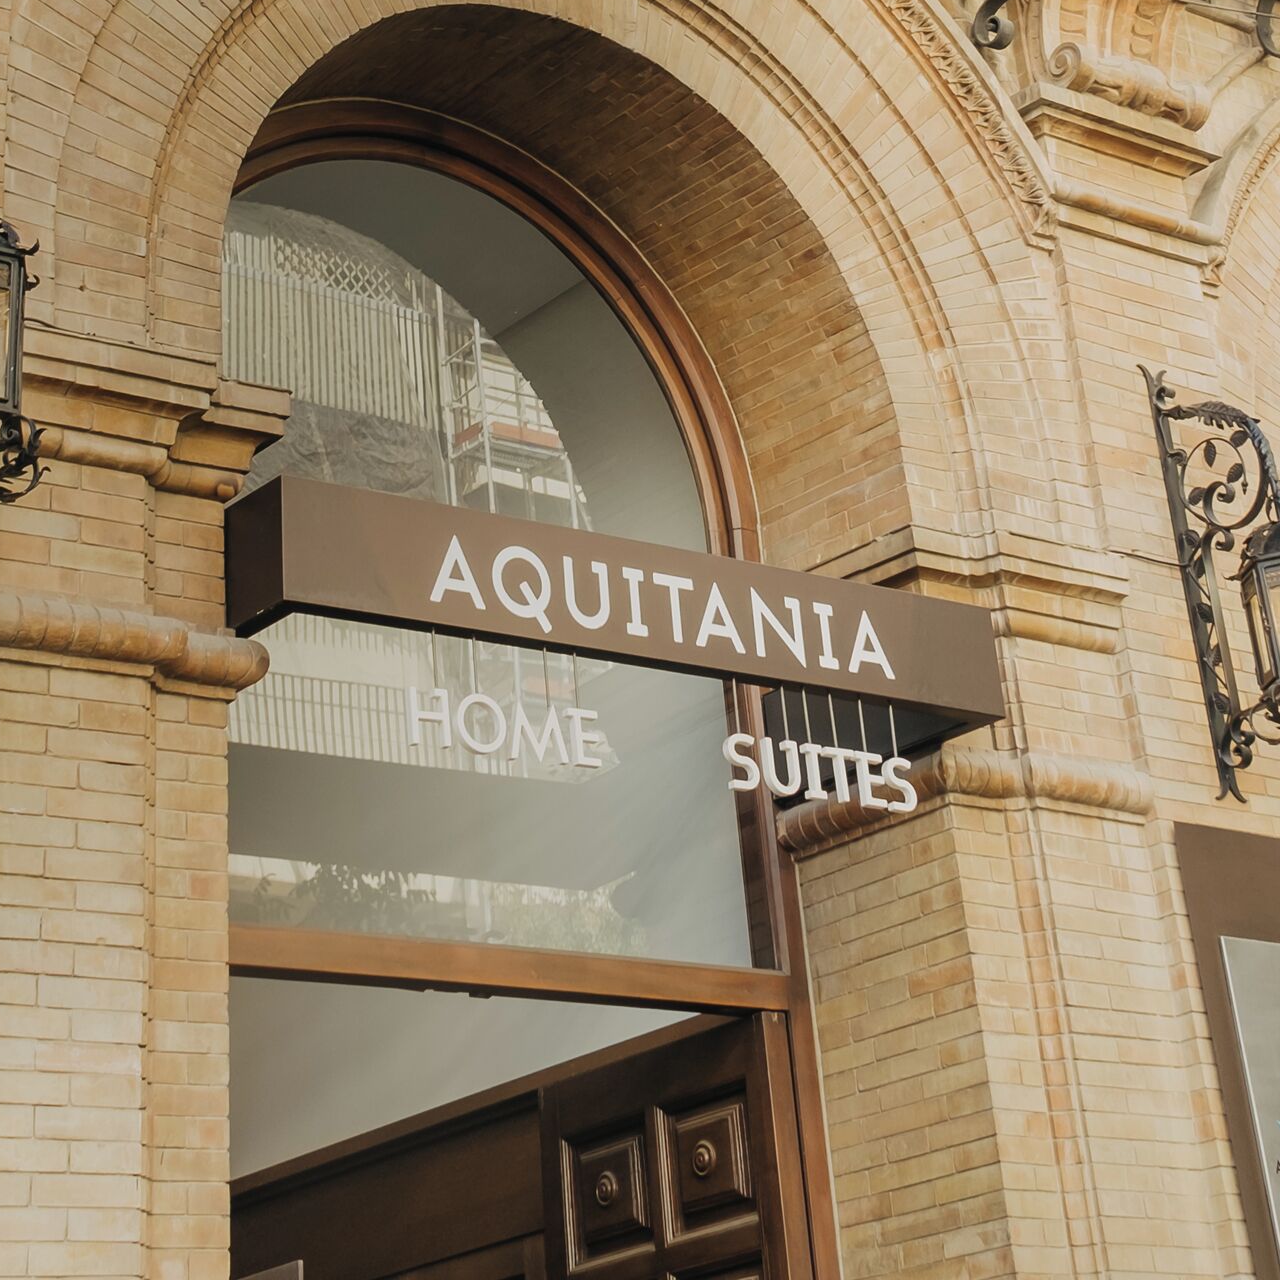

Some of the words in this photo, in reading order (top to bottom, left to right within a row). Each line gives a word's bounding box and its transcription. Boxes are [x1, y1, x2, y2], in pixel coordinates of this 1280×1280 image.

[427, 534, 897, 681] AQUITANIA
[406, 685, 605, 769] HOME
[722, 732, 919, 815] SUITES
